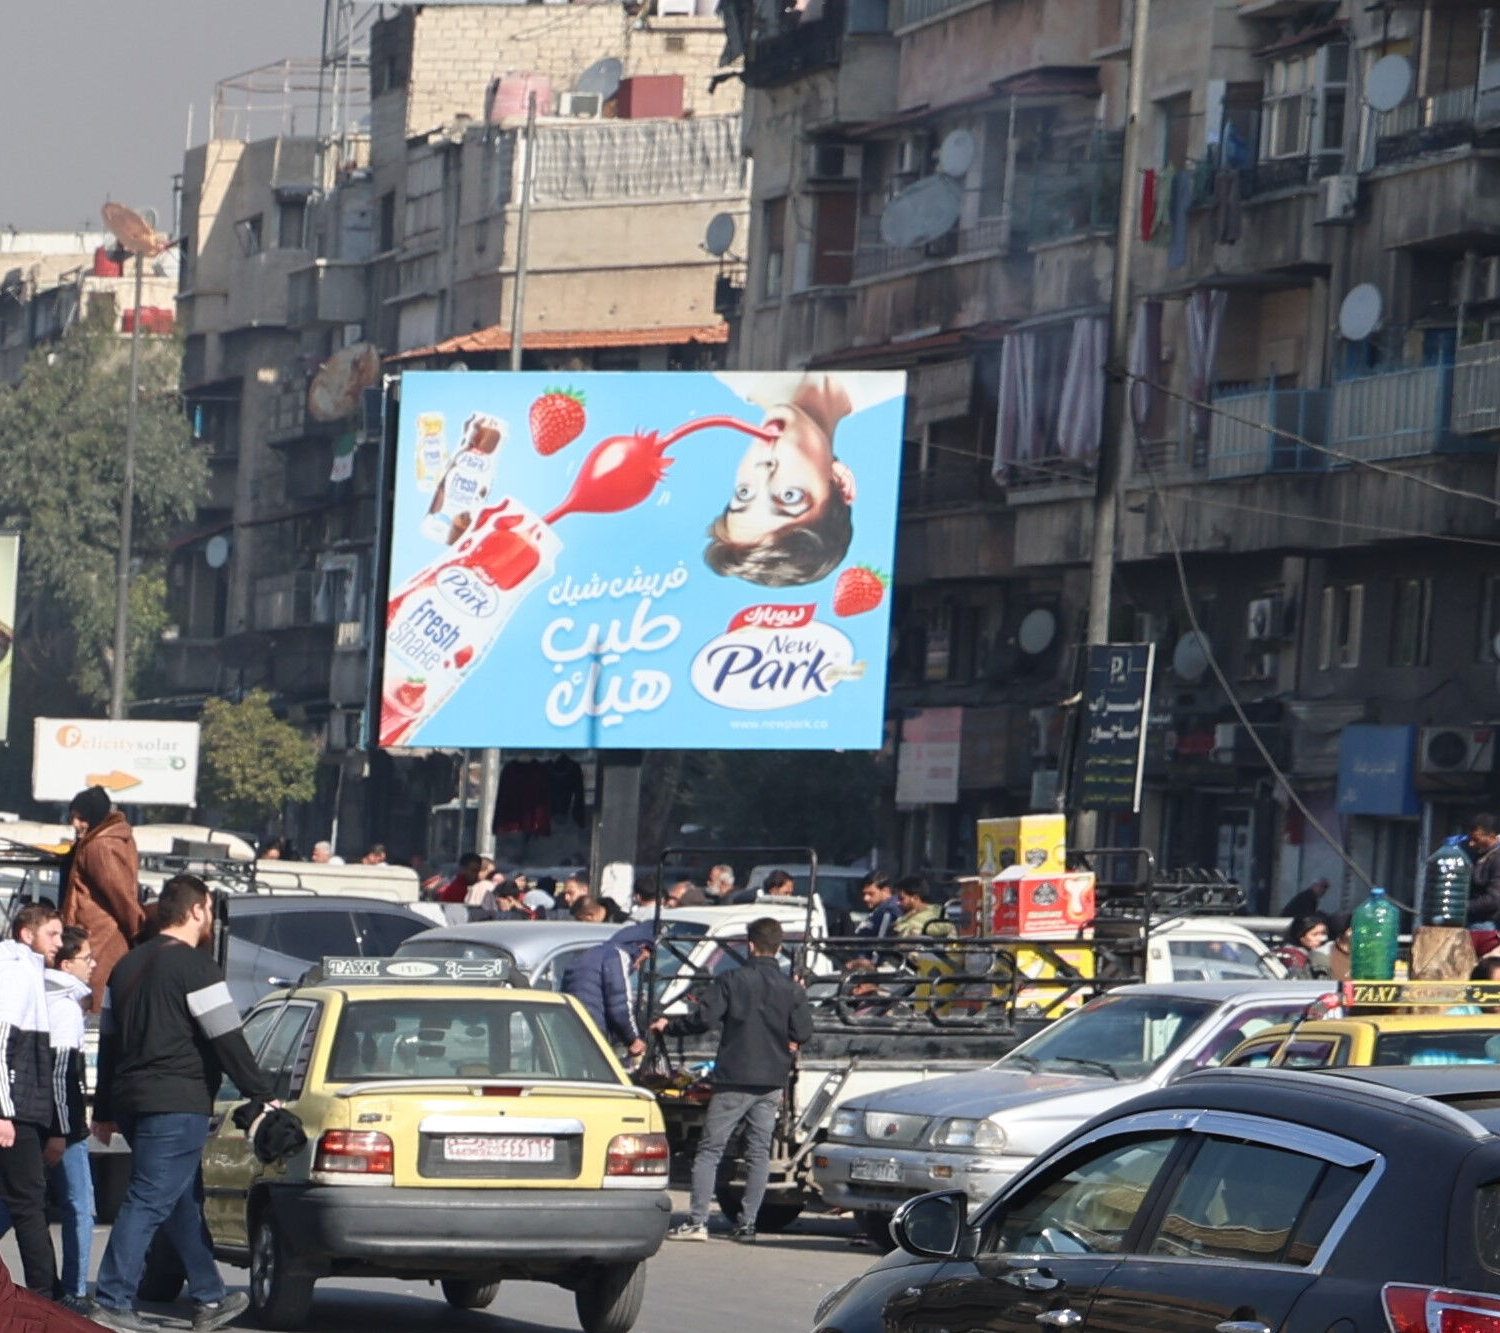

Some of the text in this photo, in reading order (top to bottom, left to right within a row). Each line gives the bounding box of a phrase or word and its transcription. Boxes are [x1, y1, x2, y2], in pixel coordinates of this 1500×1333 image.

[441, 571, 489, 617] Park
[609, 559, 689, 598] فريش
[540, 597, 682, 675] طيب
[765, 634, 818, 655] New
[707, 643, 833, 693] Park
[545, 662, 672, 728] هيك
[729, 719, 829, 730] www.newpark.co
[329, 959, 380, 977] TAXI
[1353, 986, 1397, 1002] TAXI
